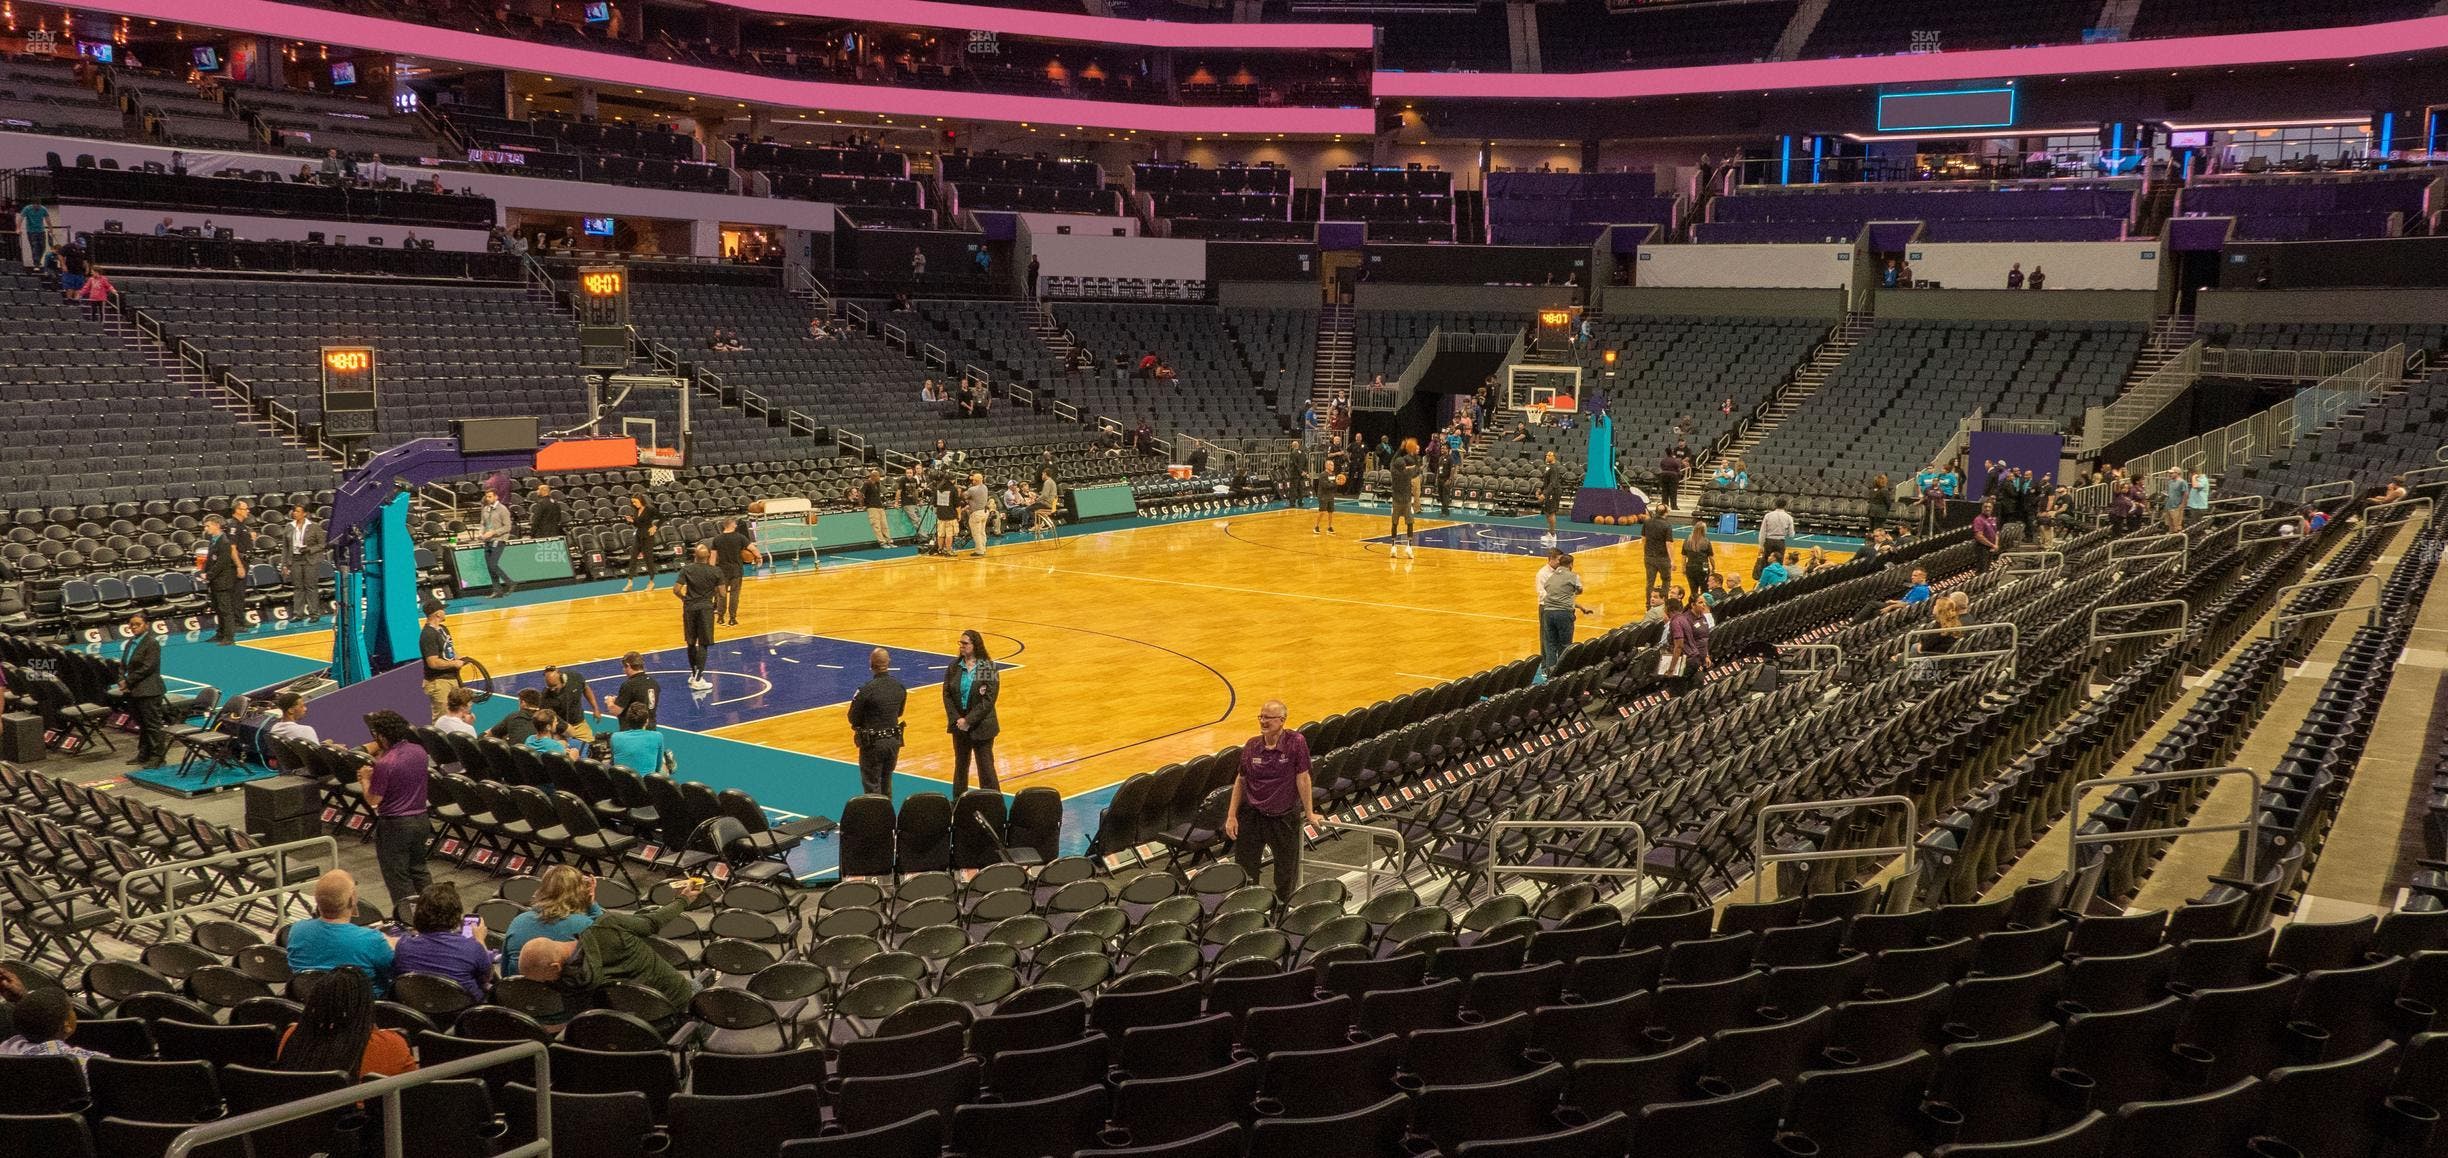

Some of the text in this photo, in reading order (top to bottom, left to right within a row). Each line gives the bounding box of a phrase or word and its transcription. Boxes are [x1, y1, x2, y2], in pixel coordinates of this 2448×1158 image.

[584, 274, 620, 293] 48:07
[1543, 314, 1568, 324] 48:07
[327, 352, 366, 368] 48:07
[432, 588, 446, 600] G
[246, 610, 261, 624] G
[273, 606, 289, 620] G
[152, 620, 169, 634] G
[184, 616, 200, 630] G
[84, 628, 102, 643] G
